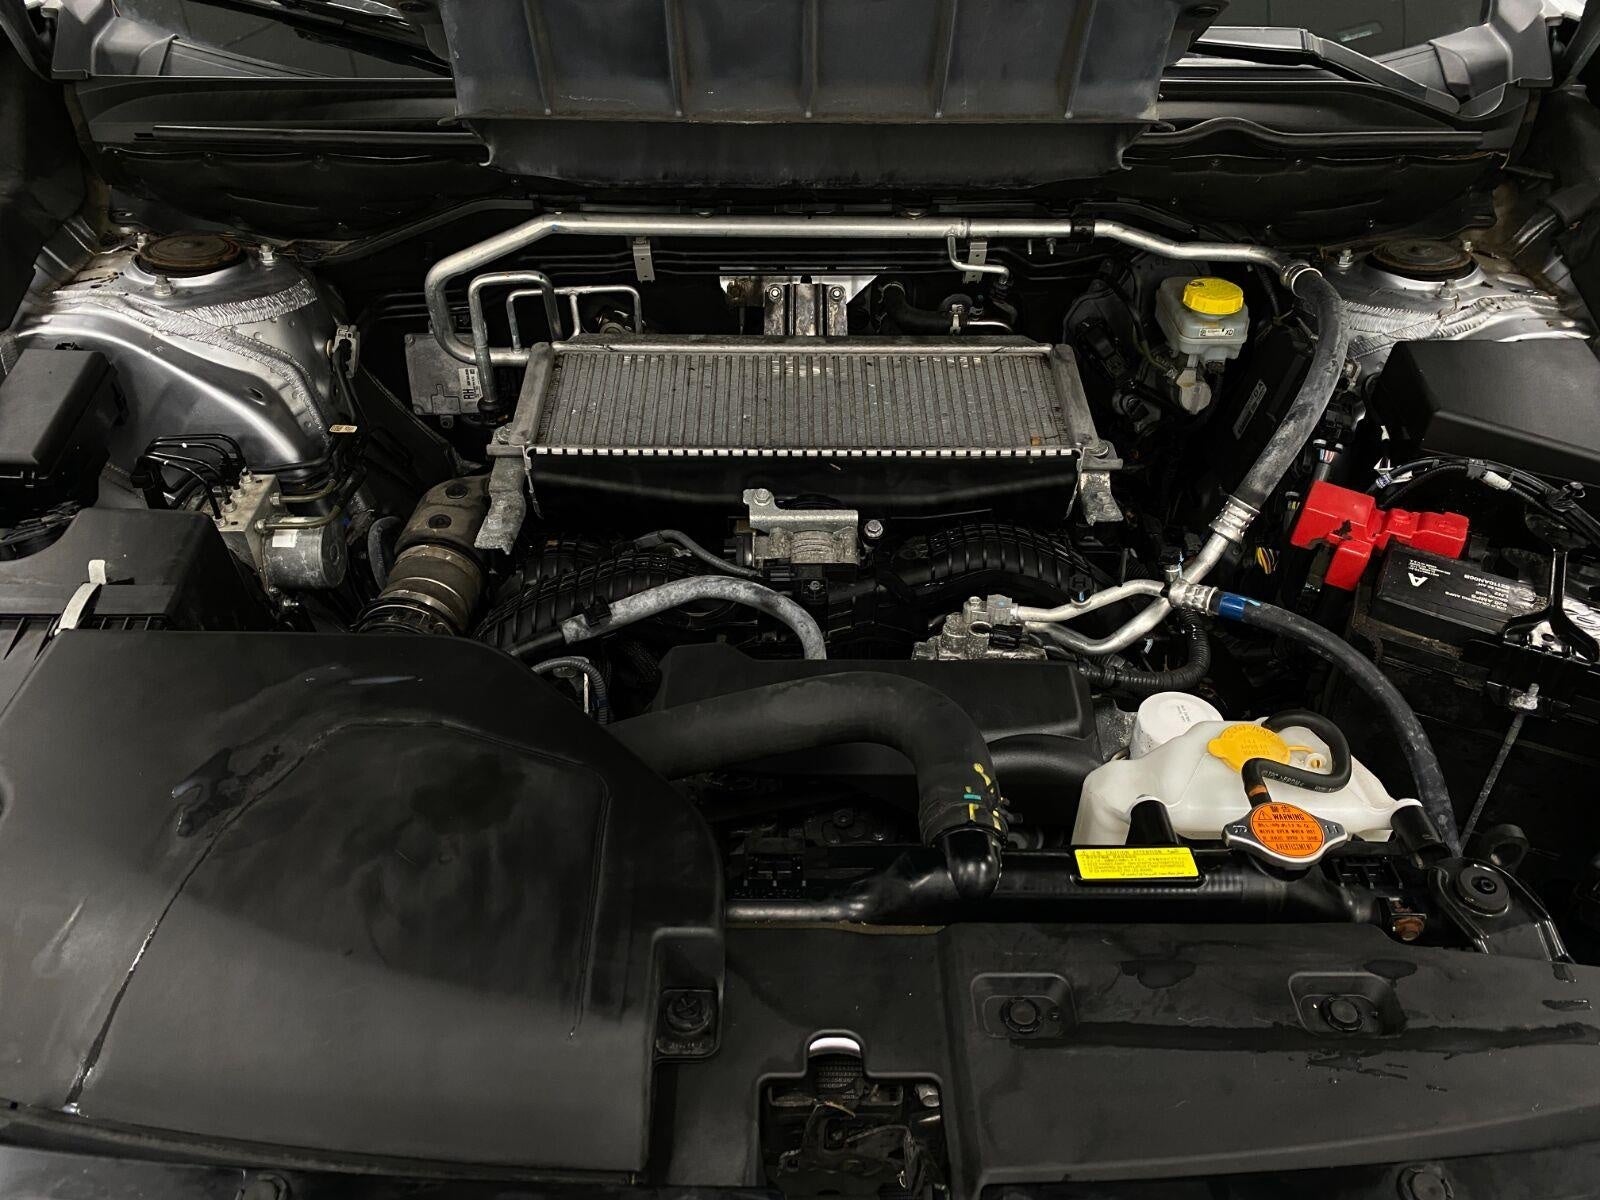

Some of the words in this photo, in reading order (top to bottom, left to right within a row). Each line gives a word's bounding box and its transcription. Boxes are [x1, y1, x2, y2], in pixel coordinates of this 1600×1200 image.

[463, 388, 474, 399] RH
[1408, 572, 1429, 587] A
[1272, 813, 1305, 821] WARNING
